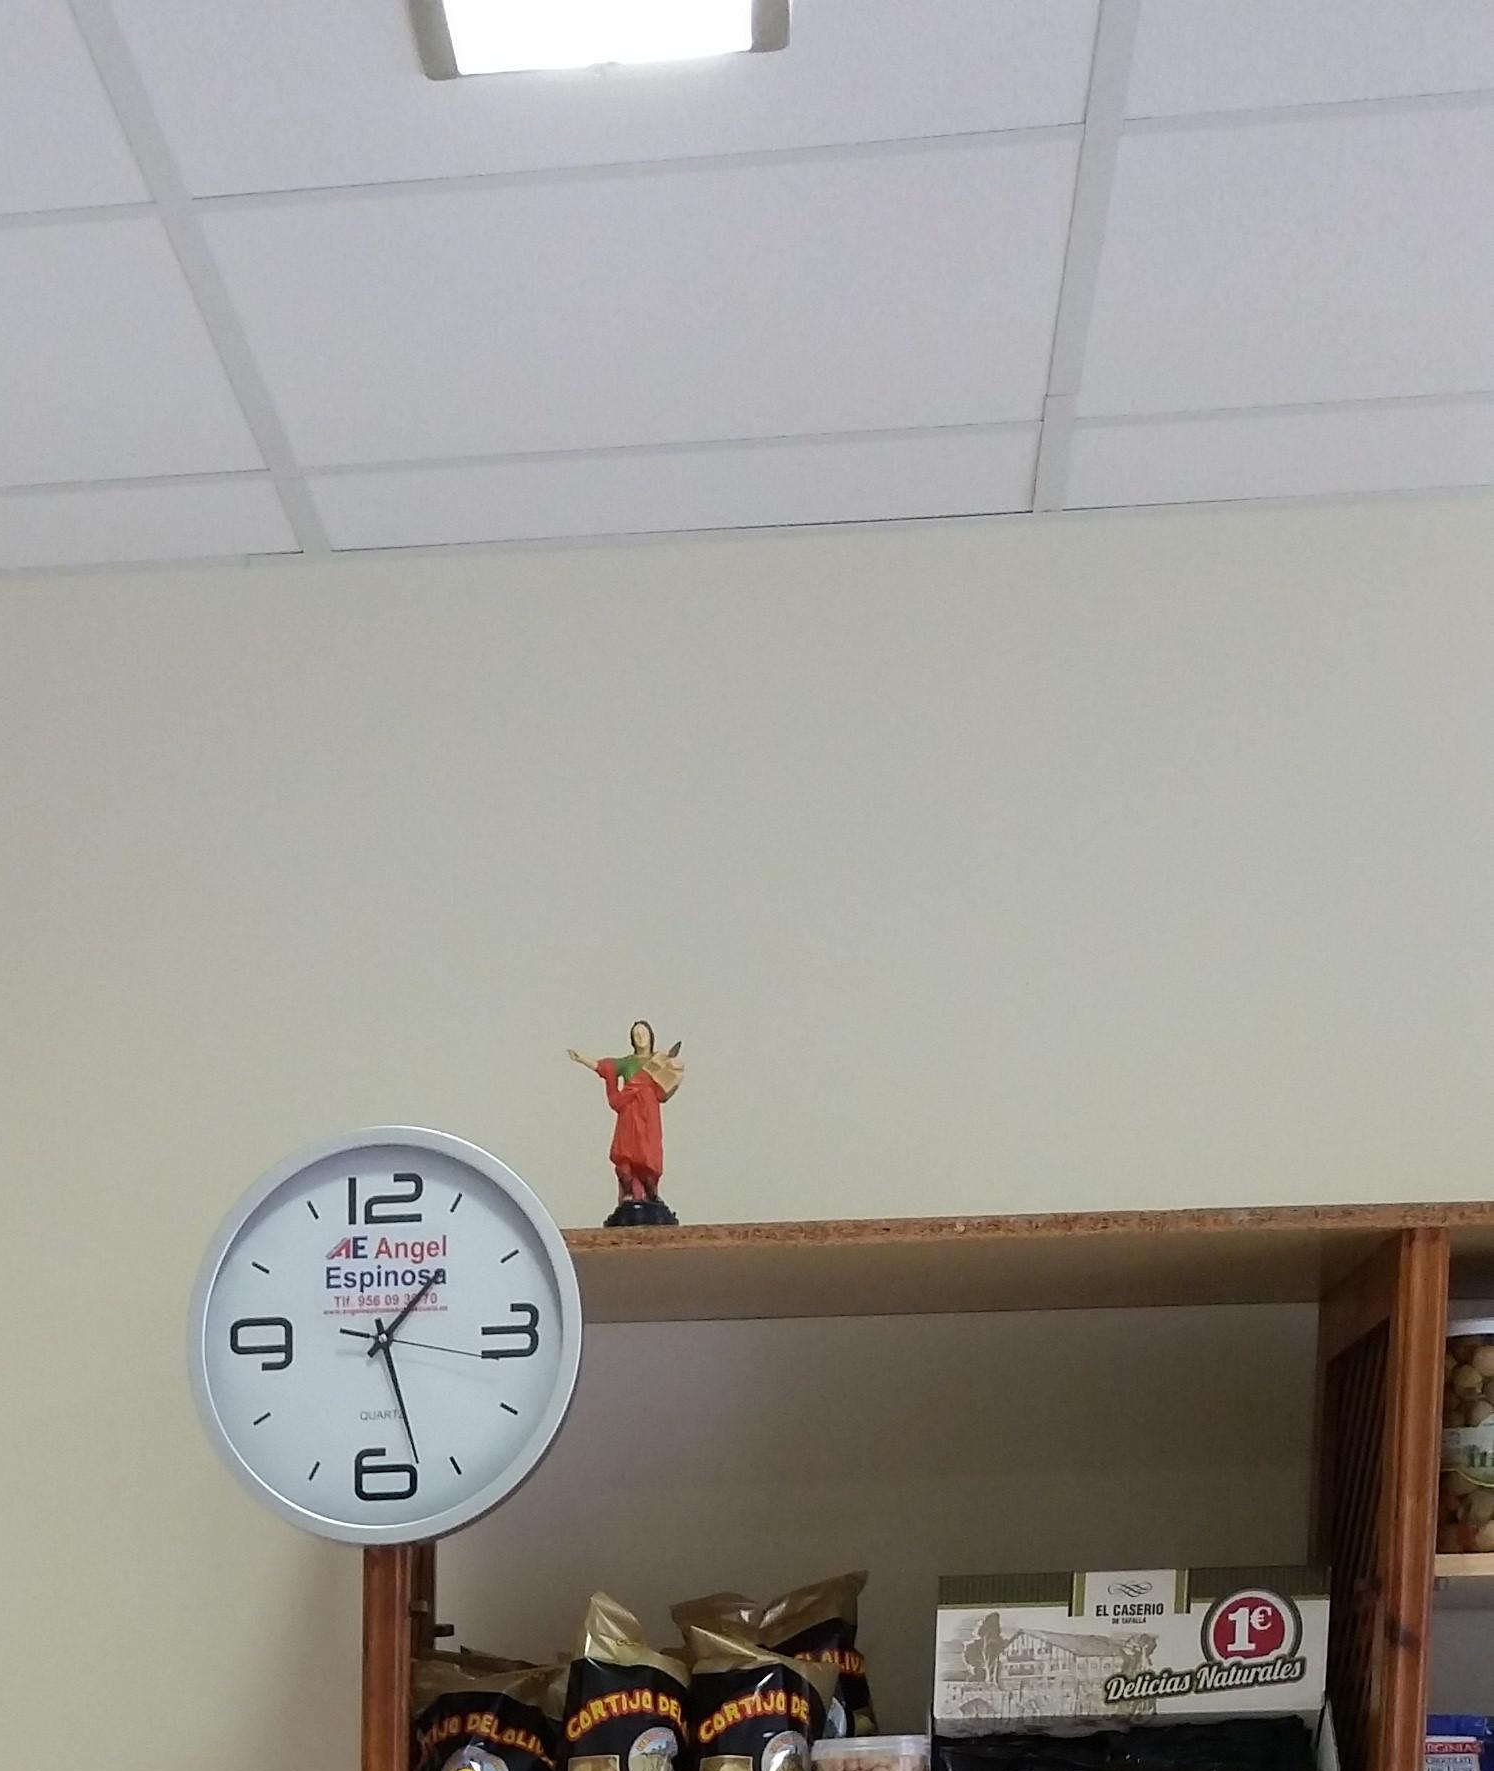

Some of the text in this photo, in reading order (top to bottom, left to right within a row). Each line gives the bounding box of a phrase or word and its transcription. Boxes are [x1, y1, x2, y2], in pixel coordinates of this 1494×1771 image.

[348, 1173, 423, 1225] 12
[374, 1235, 447, 1264] Angel
[326, 1265, 447, 1293] Espinosa
[358, 1295, 380, 1307] 956
[385, 1294, 399, 1306] 09
[230, 1317, 293, 1371] 9
[481, 1303, 539, 1359] 3
[354, 1448, 418, 1501] 6
[1096, 1603, 1164, 1617] EL CASERIO
[1227, 1606, 1273, 1652] 1€
[1106, 1659, 1301, 1700] Delicias Naturales
[567, 1690, 653, 1739] CORTIJO
[700, 1691, 787, 1742] CORTIJO
